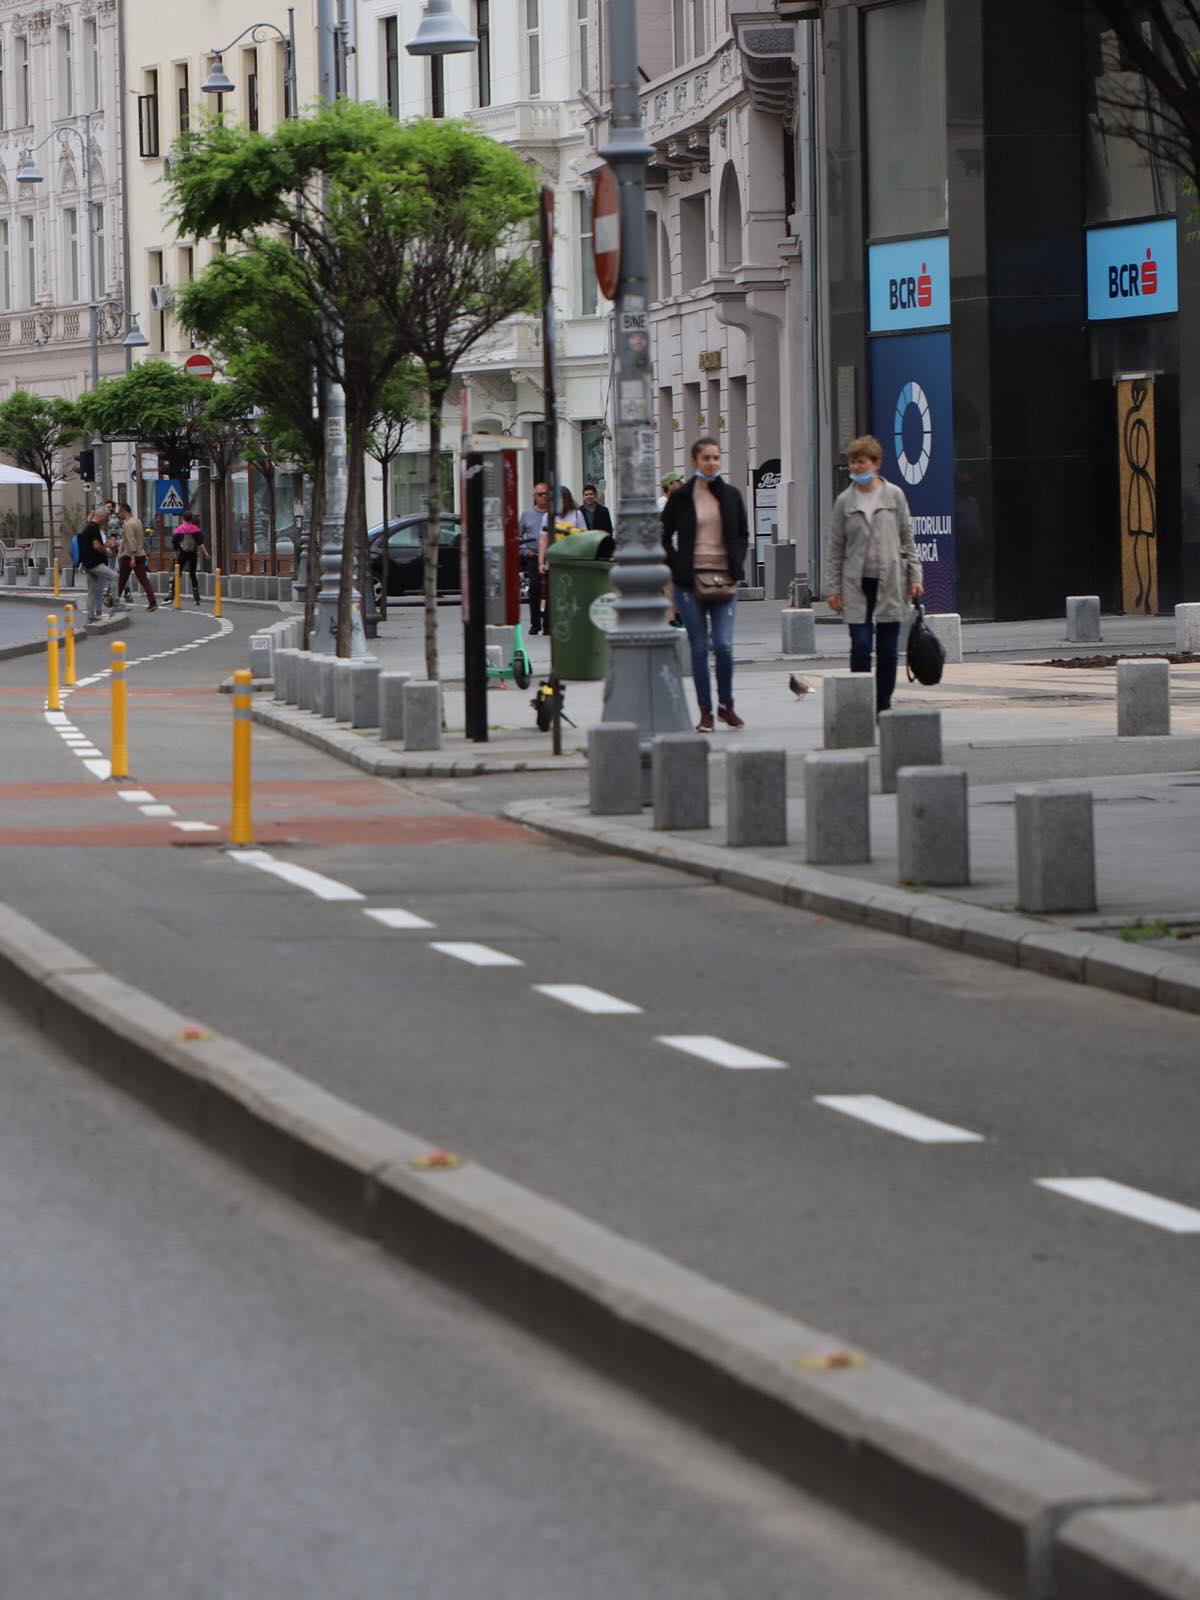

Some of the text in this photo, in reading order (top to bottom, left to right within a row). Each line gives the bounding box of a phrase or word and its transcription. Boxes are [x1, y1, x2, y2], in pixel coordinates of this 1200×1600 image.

[889, 276, 917, 310] BCR
[1108, 263, 1140, 299] BCR
[916, 538, 939, 562] ARCĂ
